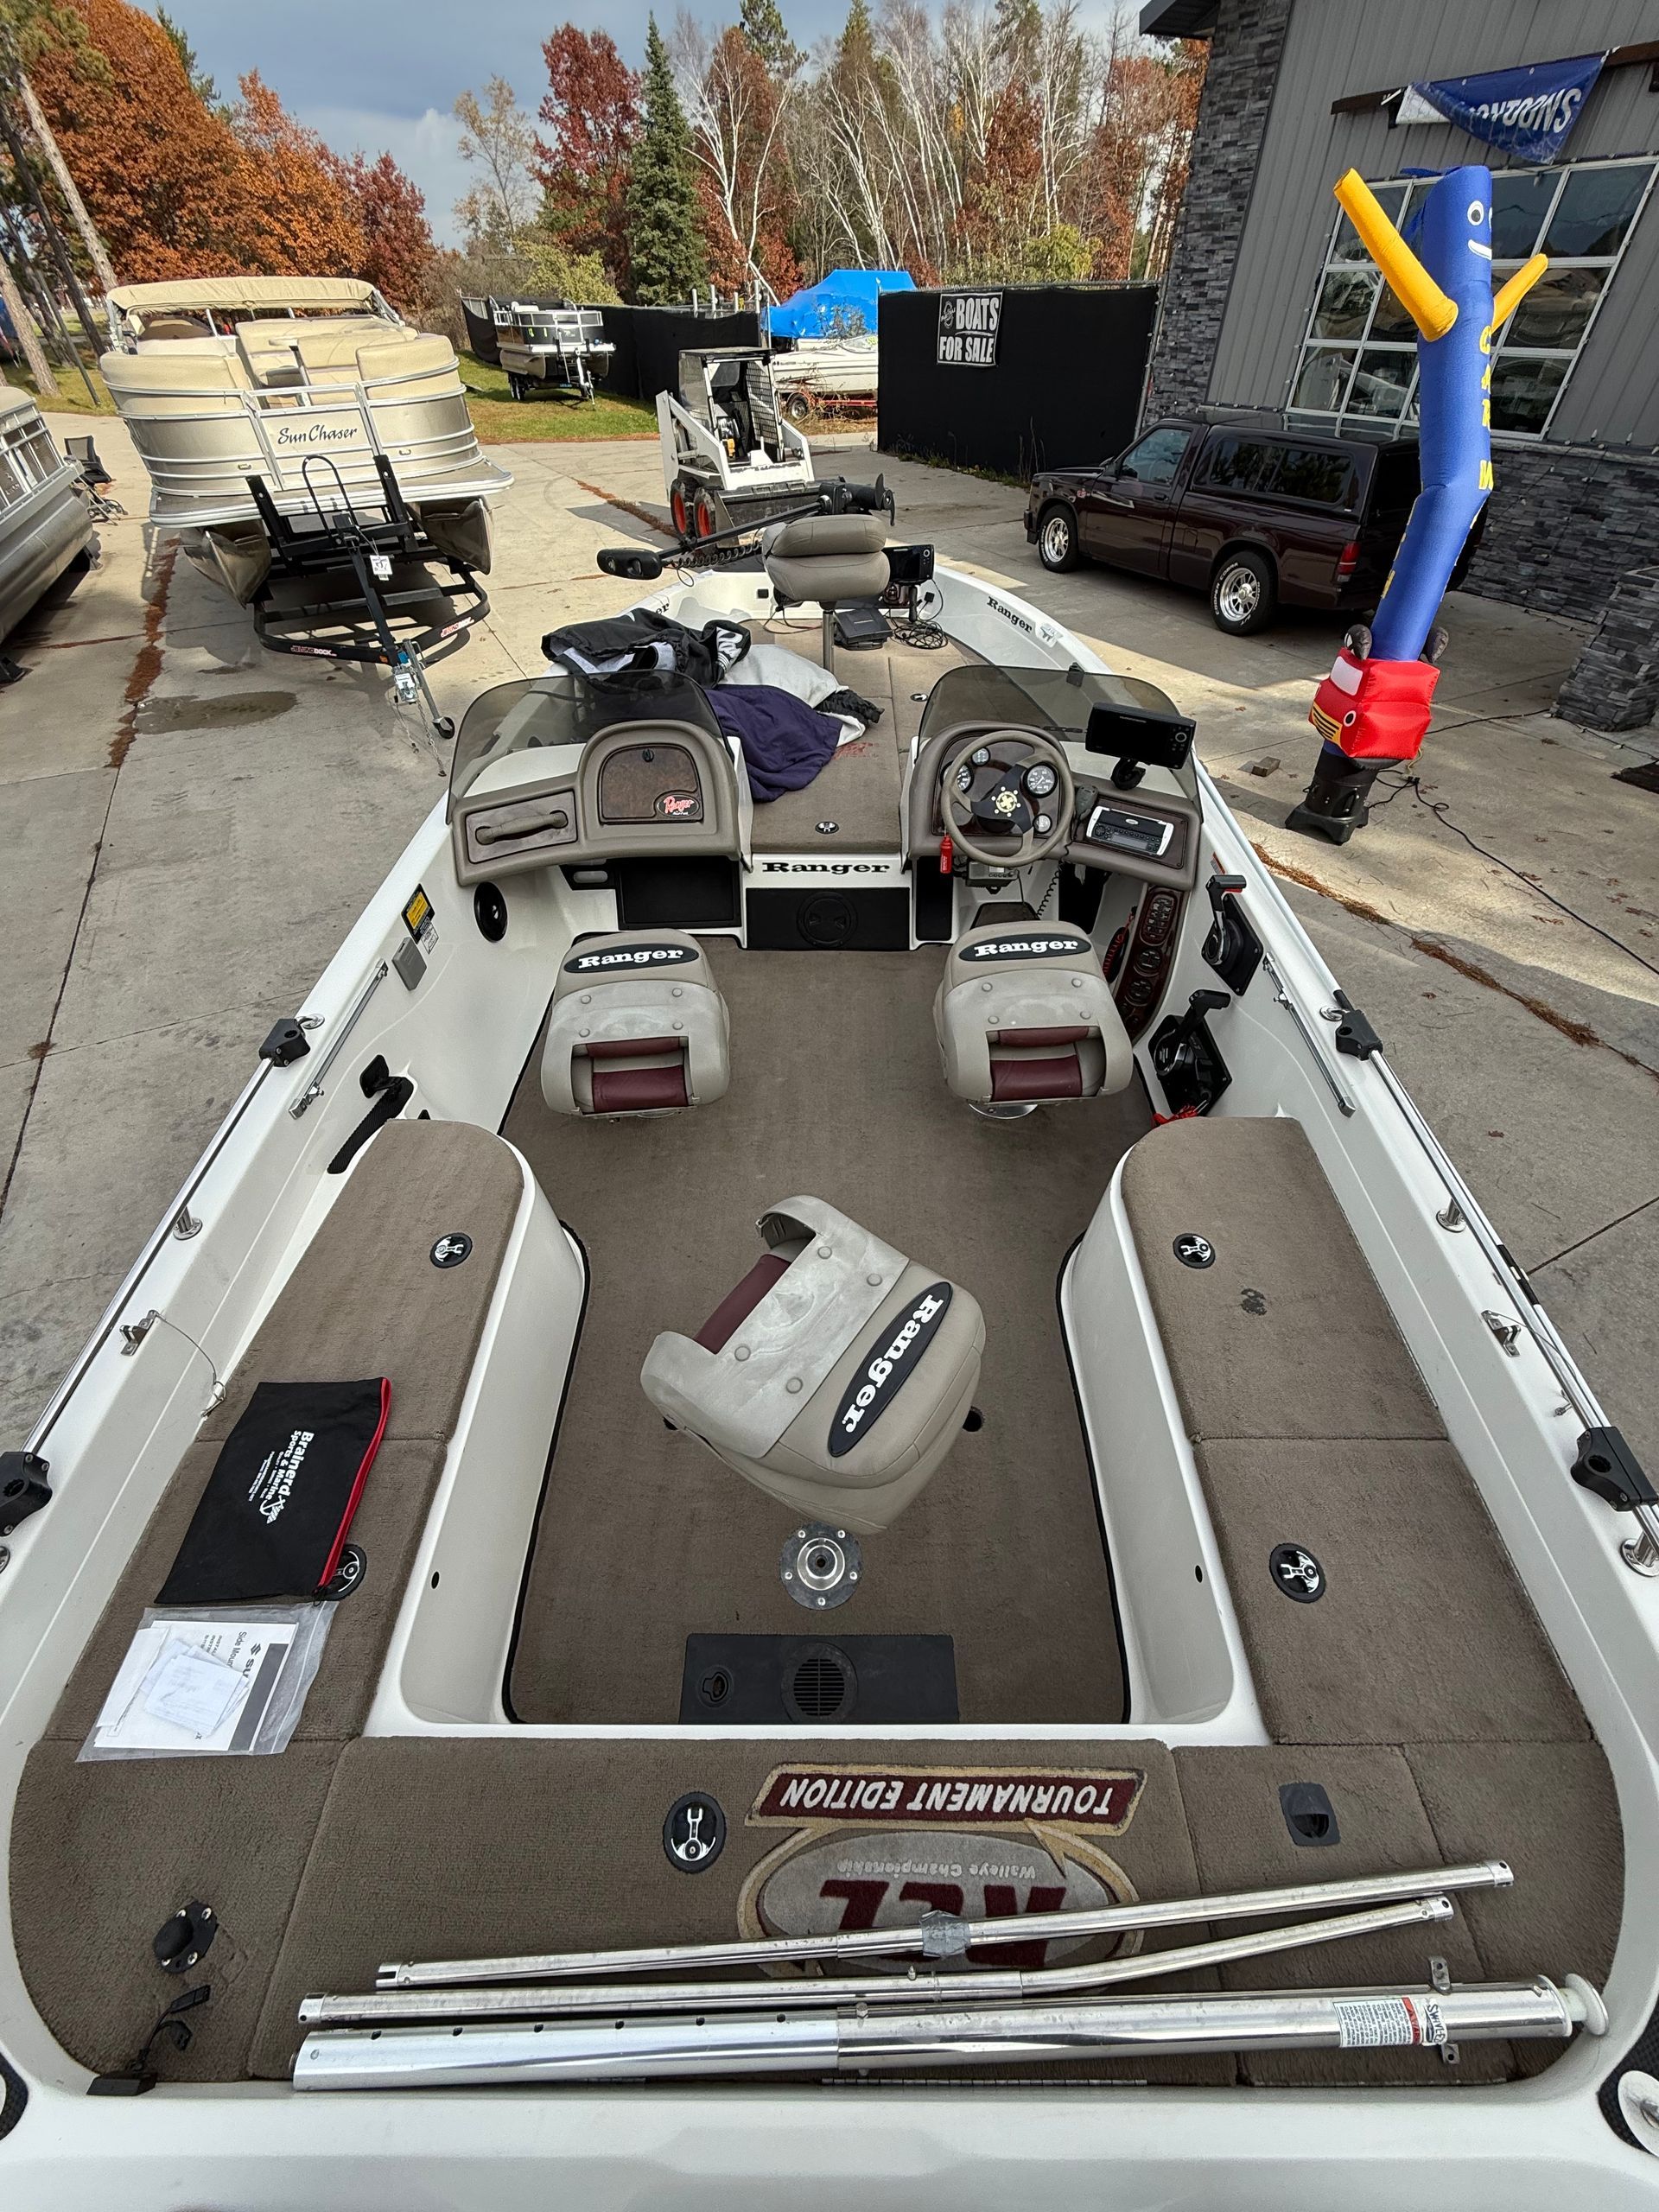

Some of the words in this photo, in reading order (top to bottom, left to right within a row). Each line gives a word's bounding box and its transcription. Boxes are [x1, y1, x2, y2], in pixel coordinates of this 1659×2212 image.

[956, 297, 999, 330] BOATS
[939, 336, 963, 360] FOR
[965, 336, 994, 363] SALE
[987, 595, 1033, 633] Ranger
[762, 862, 890, 874] Ranger
[578, 950, 683, 969] Ranger
[974, 940, 1078, 957] Ranger
[842, 1294, 944, 1433] Ranger
[283, 1430, 302, 1458] Sports
[277, 1431, 315, 1497] Brainerd
[280, 1459, 289, 1467] &
[265, 1469, 286, 1500] Marine
[779, 1778, 905, 1809] EDITION
[906, 1783, 1113, 1815] TOURNAMENT
[837, 1858, 962, 1878] Championship
[968, 1859, 1036, 1879] Walleye
